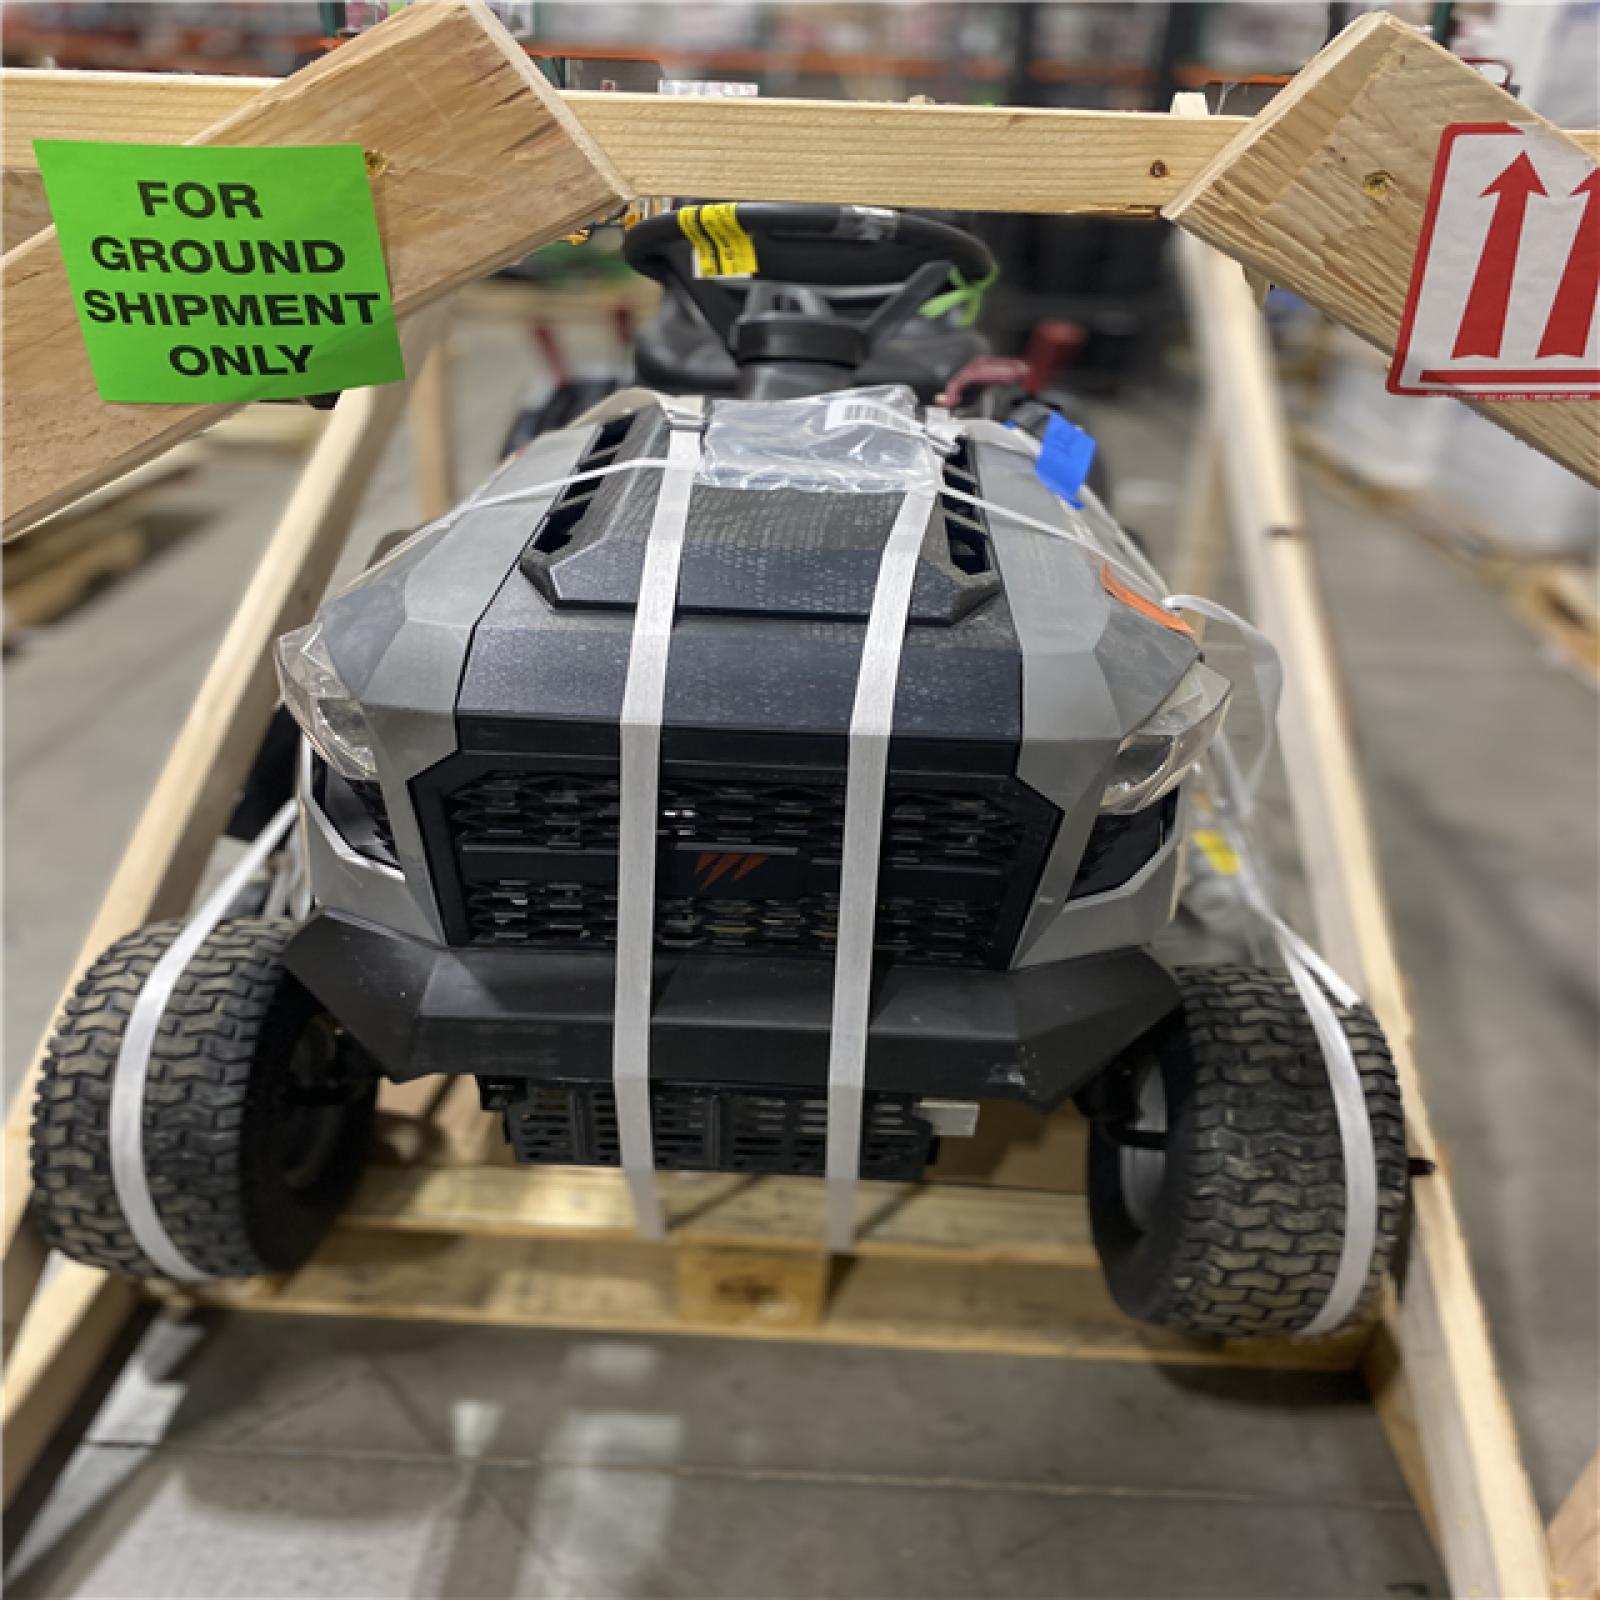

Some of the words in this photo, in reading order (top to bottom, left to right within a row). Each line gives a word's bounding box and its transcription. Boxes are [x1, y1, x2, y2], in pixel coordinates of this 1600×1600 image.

[137, 181, 262, 218] FOR
[91, 235, 345, 274] GROUND
[84, 289, 380, 326] SHIPMENT
[170, 344, 313, 376] ONLY
